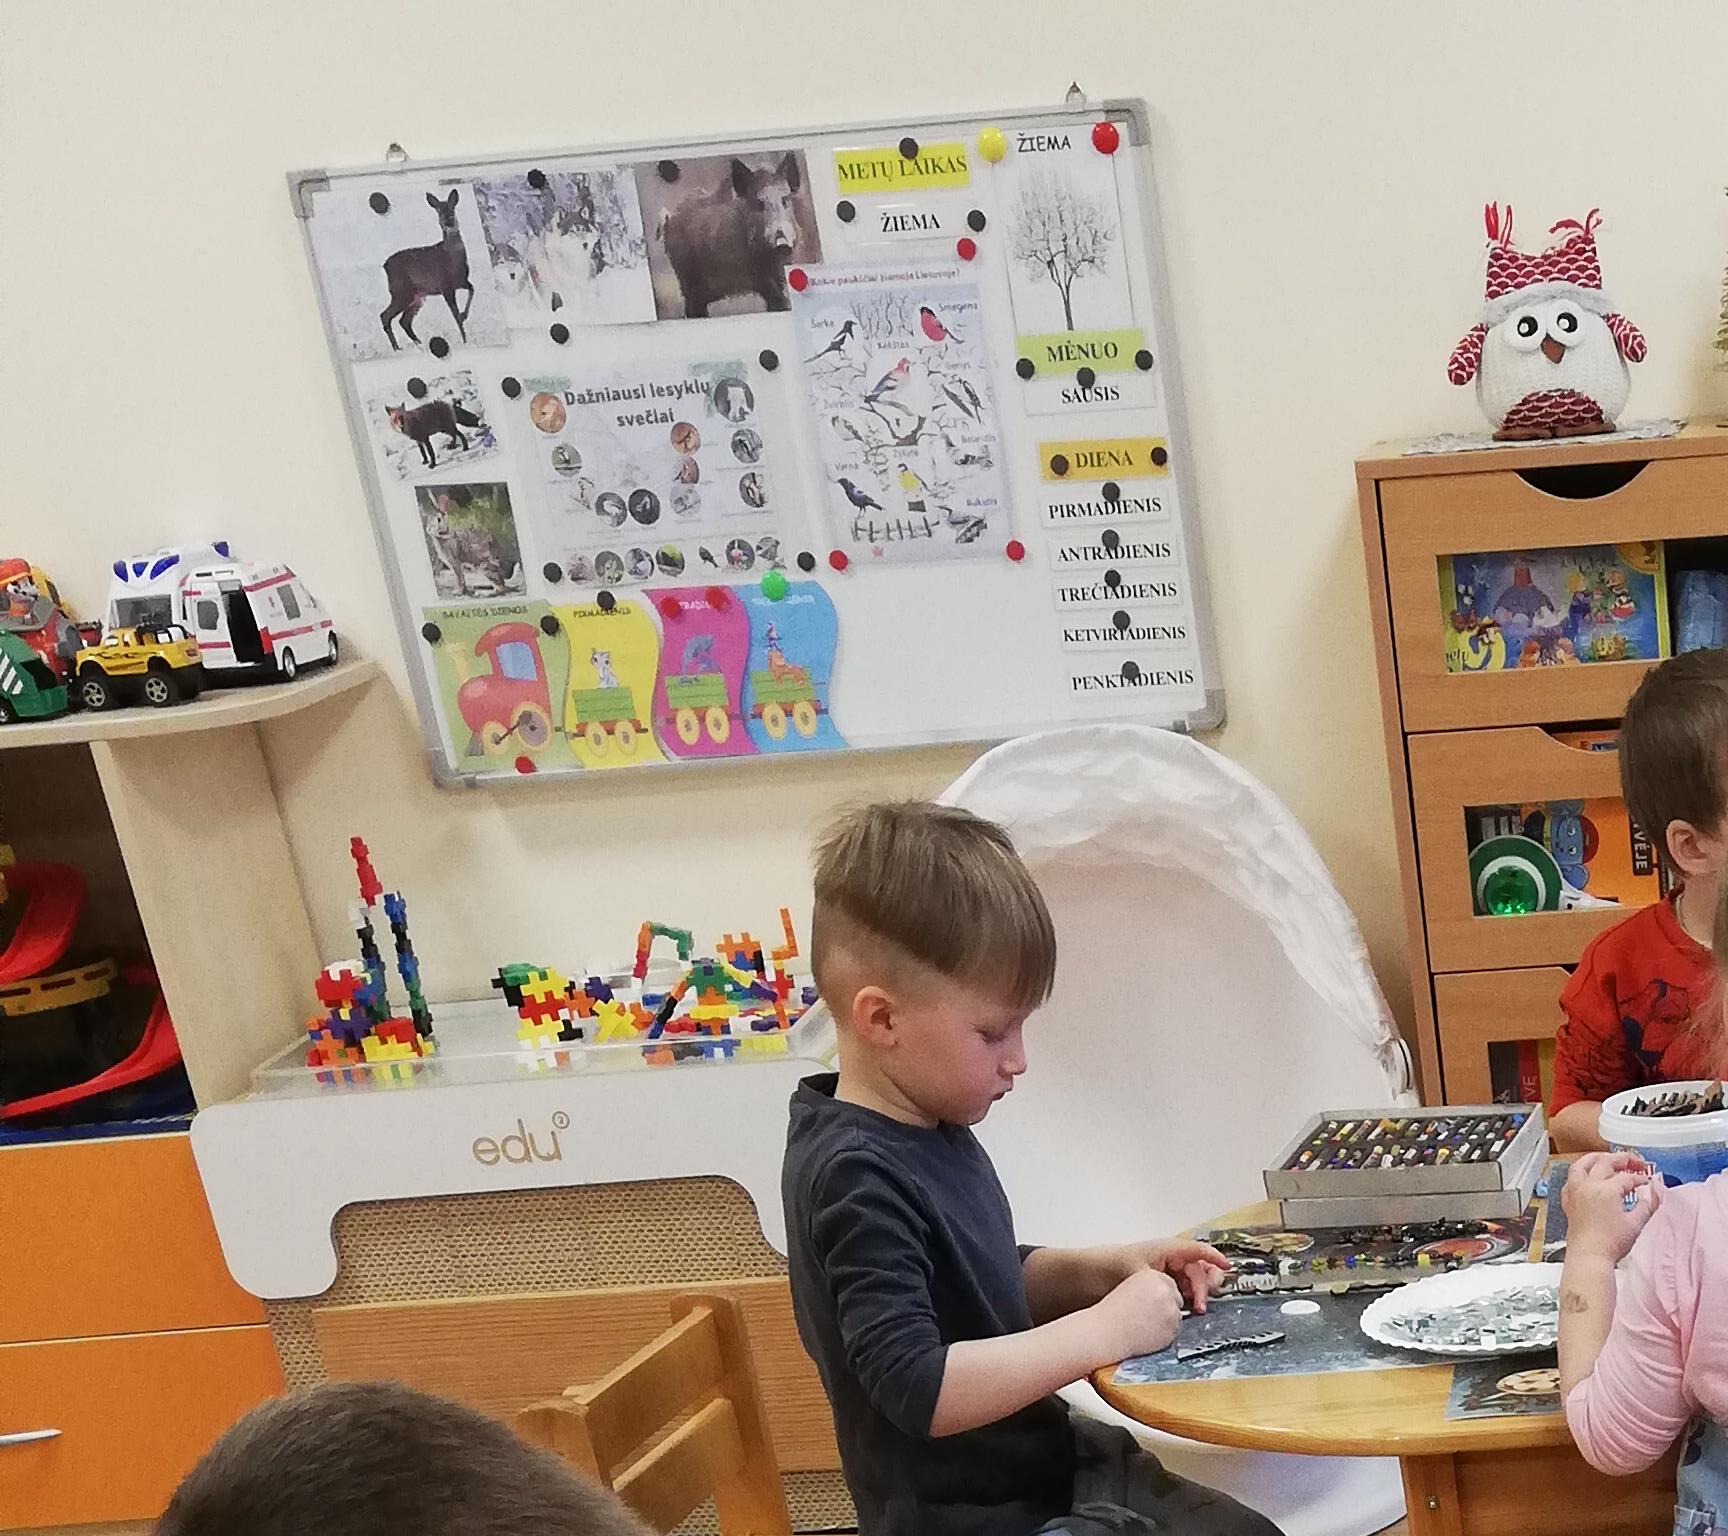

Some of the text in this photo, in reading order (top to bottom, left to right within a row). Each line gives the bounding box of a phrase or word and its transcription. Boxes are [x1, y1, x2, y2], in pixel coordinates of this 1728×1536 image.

[1017, 133, 1072, 153] ŽIEMA
[838, 155, 968, 181] METŲ LAIKAS
[881, 212, 941, 233] ŽIEMA
[1047, 340, 1119, 363] MĖNUO
[564, 384, 646, 407] Dažniausi
[1061, 386, 1120, 404] SAUSIS
[616, 408, 675, 428] svečiai
[1075, 450, 1134, 469] DIENA
[1048, 497, 1162, 519] PIRMADIENIS
[1057, 543, 1172, 562] ANTRADIENIS
[1057, 582, 1178, 602] TREČIADIENIS
[1063, 626, 1186, 642] KETVIRTADIENIS
[1072, 669, 1195, 690] PENKTADIENIS
[472, 1118, 563, 1166] edu
